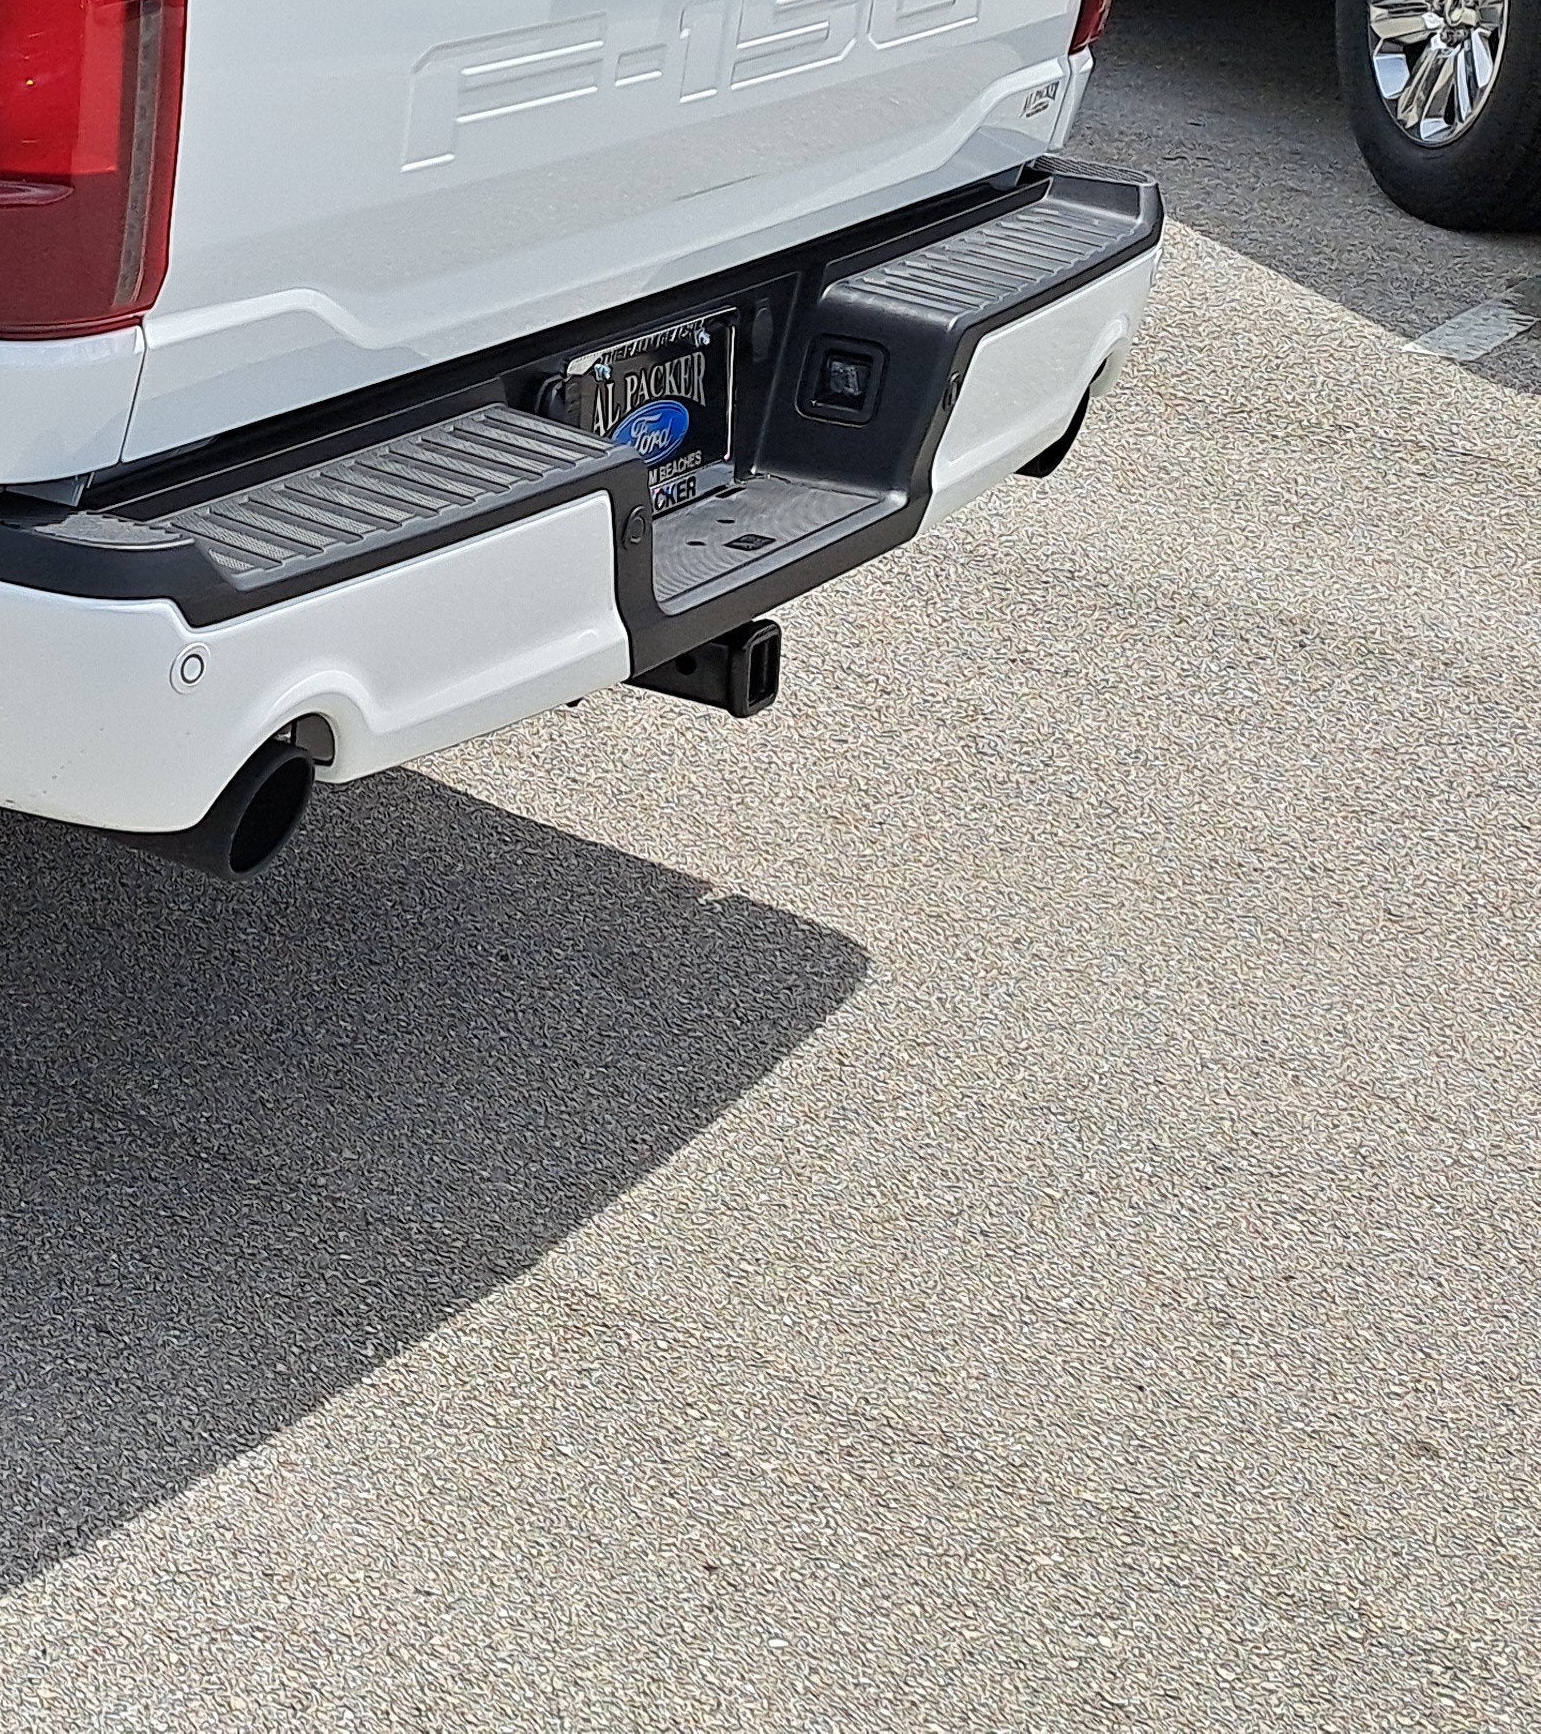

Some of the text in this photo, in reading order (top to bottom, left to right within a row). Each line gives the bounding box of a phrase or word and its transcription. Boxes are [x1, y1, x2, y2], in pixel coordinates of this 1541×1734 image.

[593, 351, 707, 437] AL PACKER
[630, 413, 673, 456] Ford
